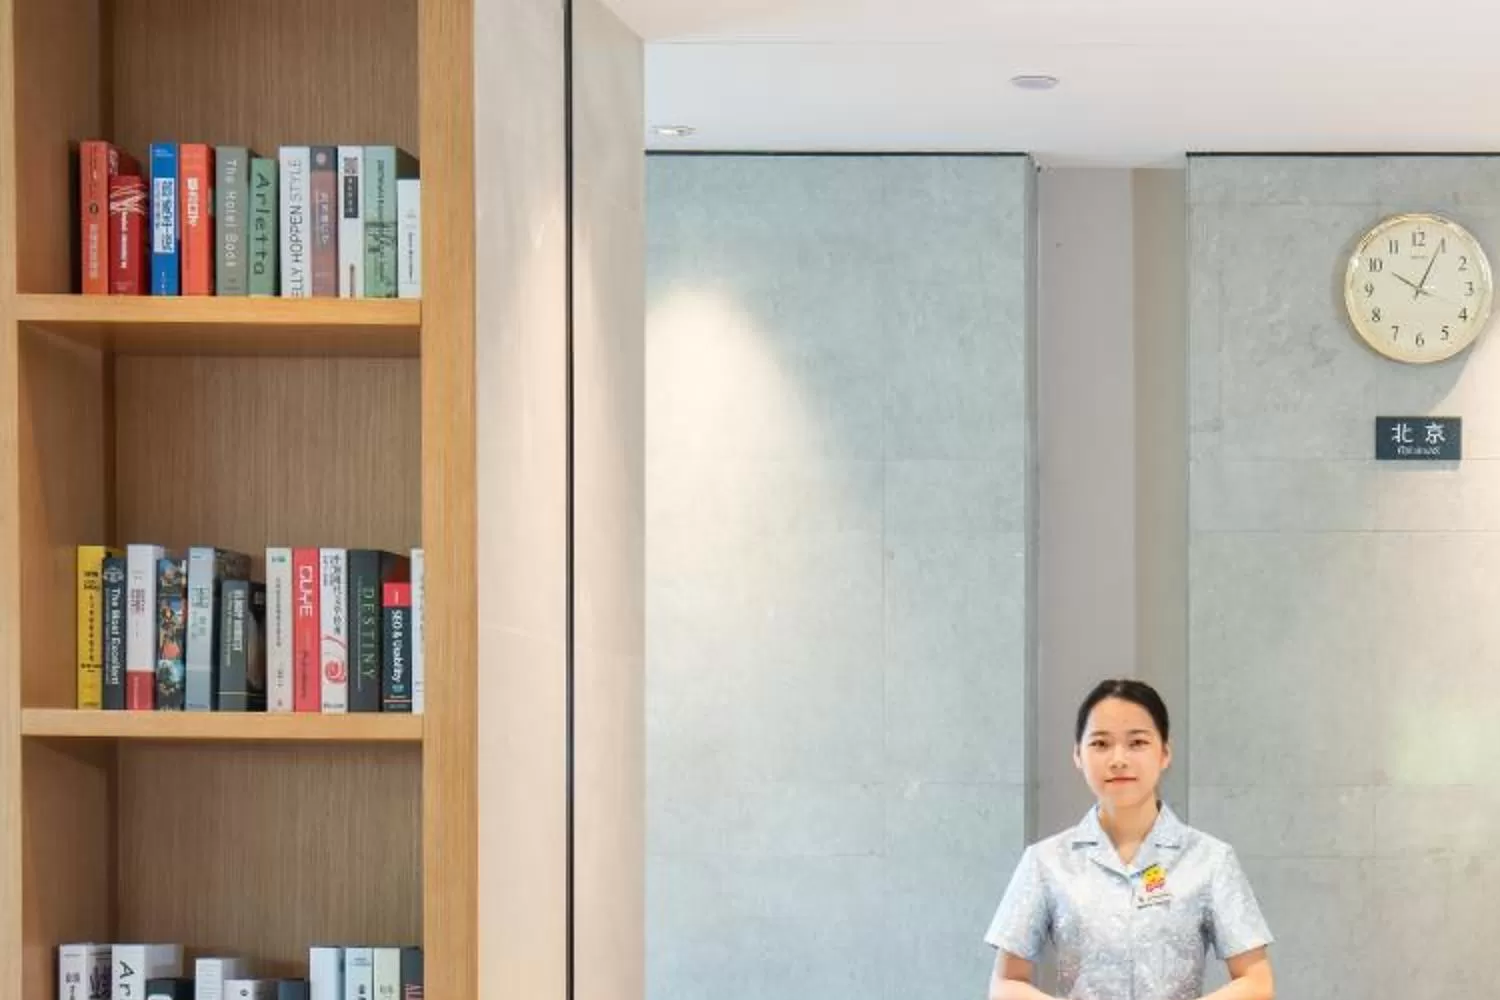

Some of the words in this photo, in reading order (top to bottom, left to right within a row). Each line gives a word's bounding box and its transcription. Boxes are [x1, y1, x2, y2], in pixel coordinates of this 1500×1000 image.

[225, 159, 237, 184] The
[288, 159, 302, 202] STYLE
[225, 191, 237, 229] Hotel
[253, 172, 273, 276] Arletta
[289, 205, 303, 263] HOPPEN
[1412, 231, 1425, 247] 12
[1388, 239, 1399, 254] 11
[1369, 257, 1383, 272] 10
[1458, 255, 1467, 271] 2
[1364, 283, 1374, 298] 9
[1464, 281, 1474, 297] 3
[1371, 307, 1381, 323] 8
[1458, 307, 1468, 321] 4
[1391, 325, 1400, 341] 7
[1415, 331, 1425, 347] 6
[1440, 325, 1449, 340] 5
[1391, 422, 1446, 444] 北京
[392, 609, 403, 629] SEO
[363, 586, 375, 680] DESTINY
[391, 639, 404, 682] Usability
